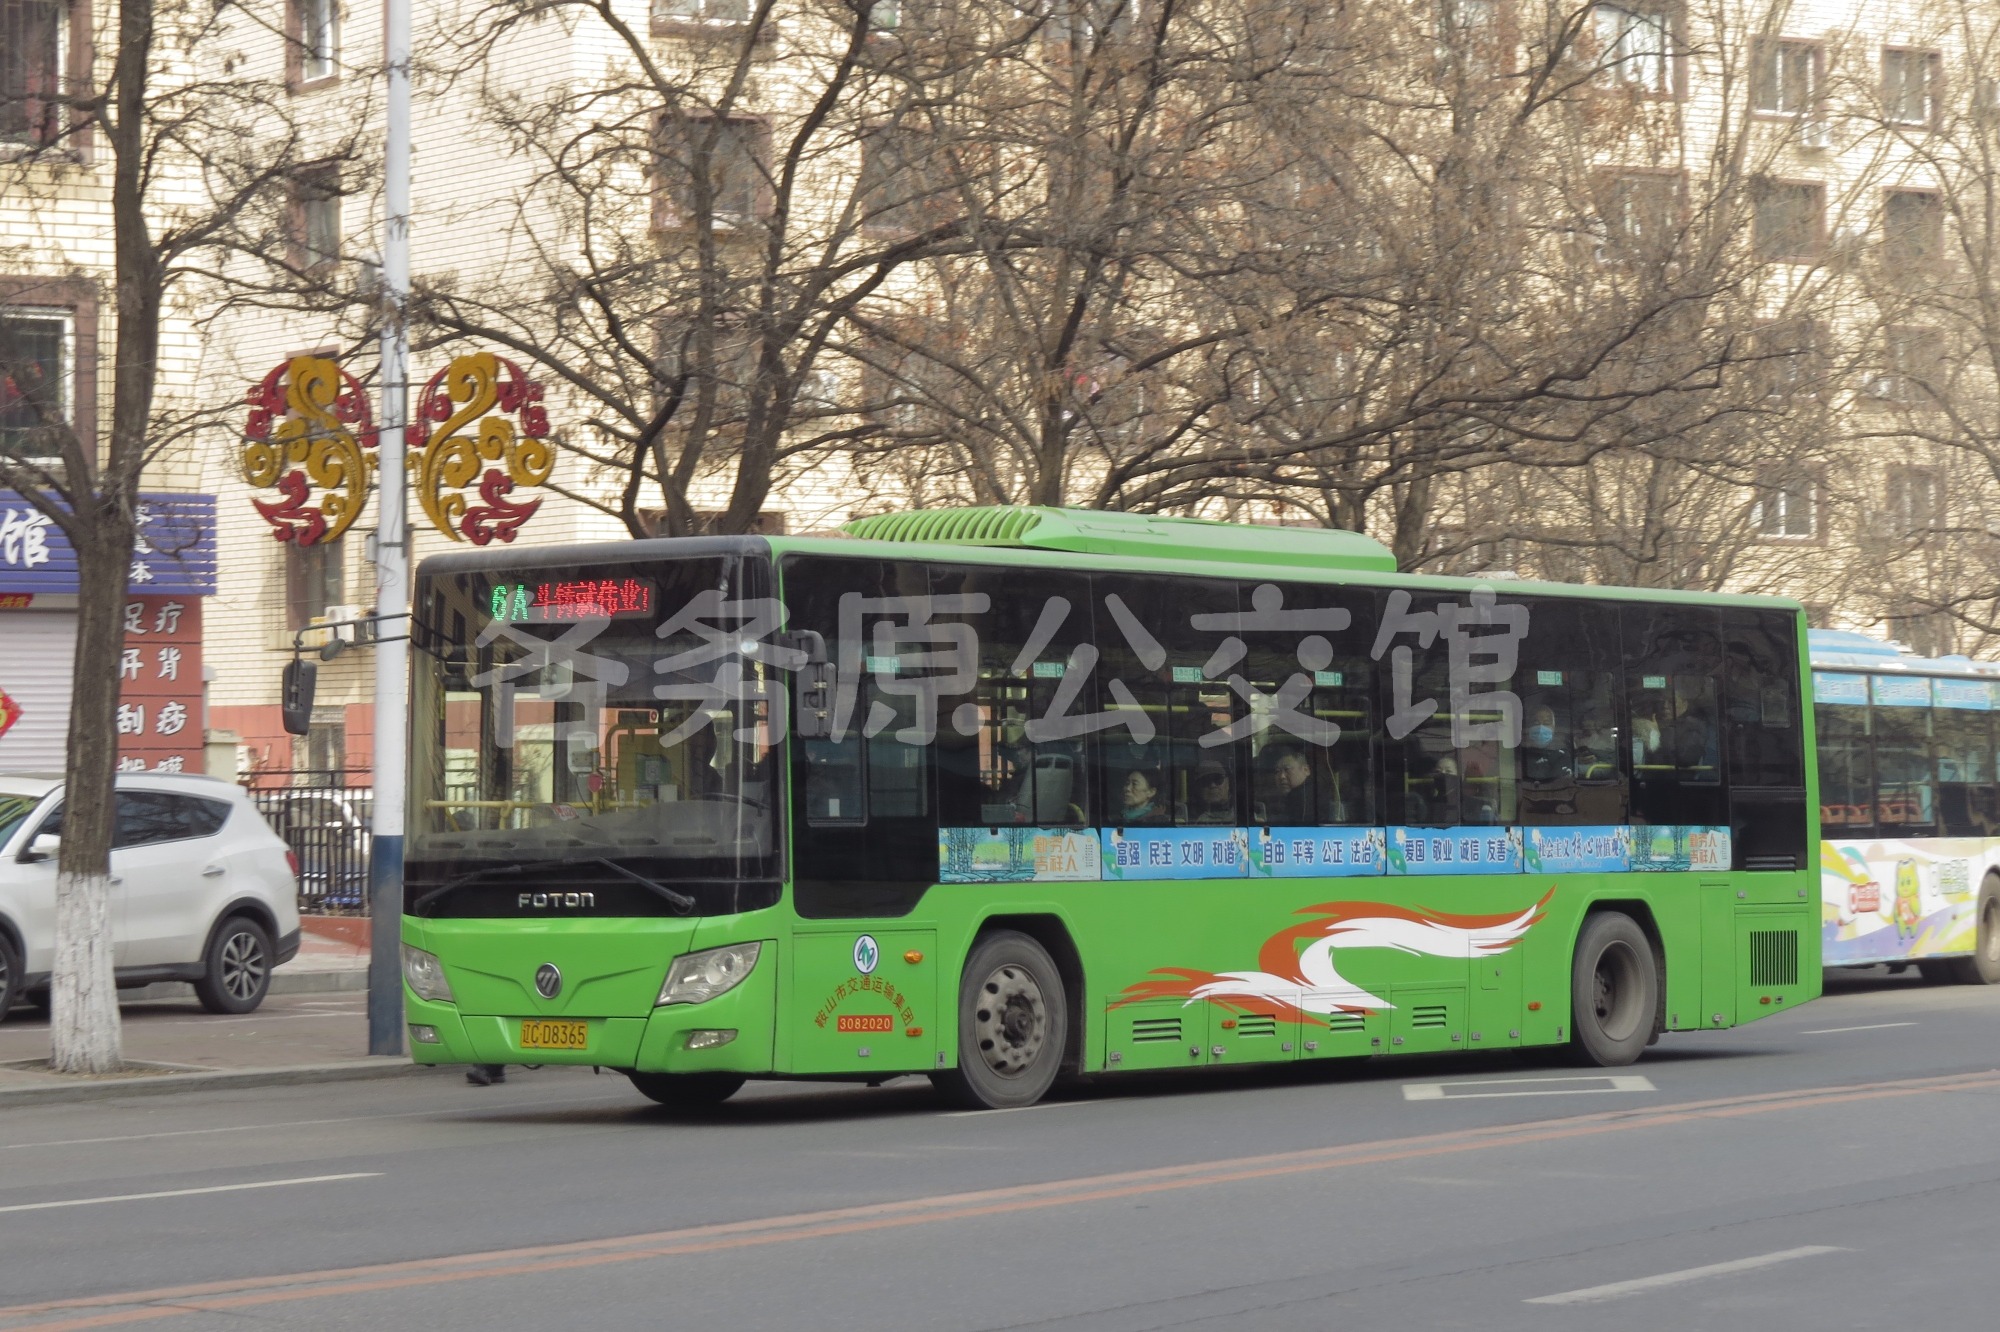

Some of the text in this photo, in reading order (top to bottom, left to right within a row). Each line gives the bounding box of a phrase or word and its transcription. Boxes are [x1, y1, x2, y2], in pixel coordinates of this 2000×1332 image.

[0, 508, 54, 568] 馆
[491, 584, 529, 621] 6A
[123, 601, 185, 635] 足疗
[117, 701, 188, 736] 刮痧
[1116, 841, 1141, 866] 富强
[1149, 841, 1173, 865] 民主
[1181, 841, 1204, 865] 文明
[1212, 840, 1235, 865] 和谐
[1263, 839, 1372, 864] 自由 平等 公正 法治
[1405, 838, 1506, 862] 爱国 敬业 诚信 友善
[1034, 854, 1078, 872] 吉祥人
[518, 892, 595, 908] FOTON
[839, 1017, 891, 1030] 3082020
